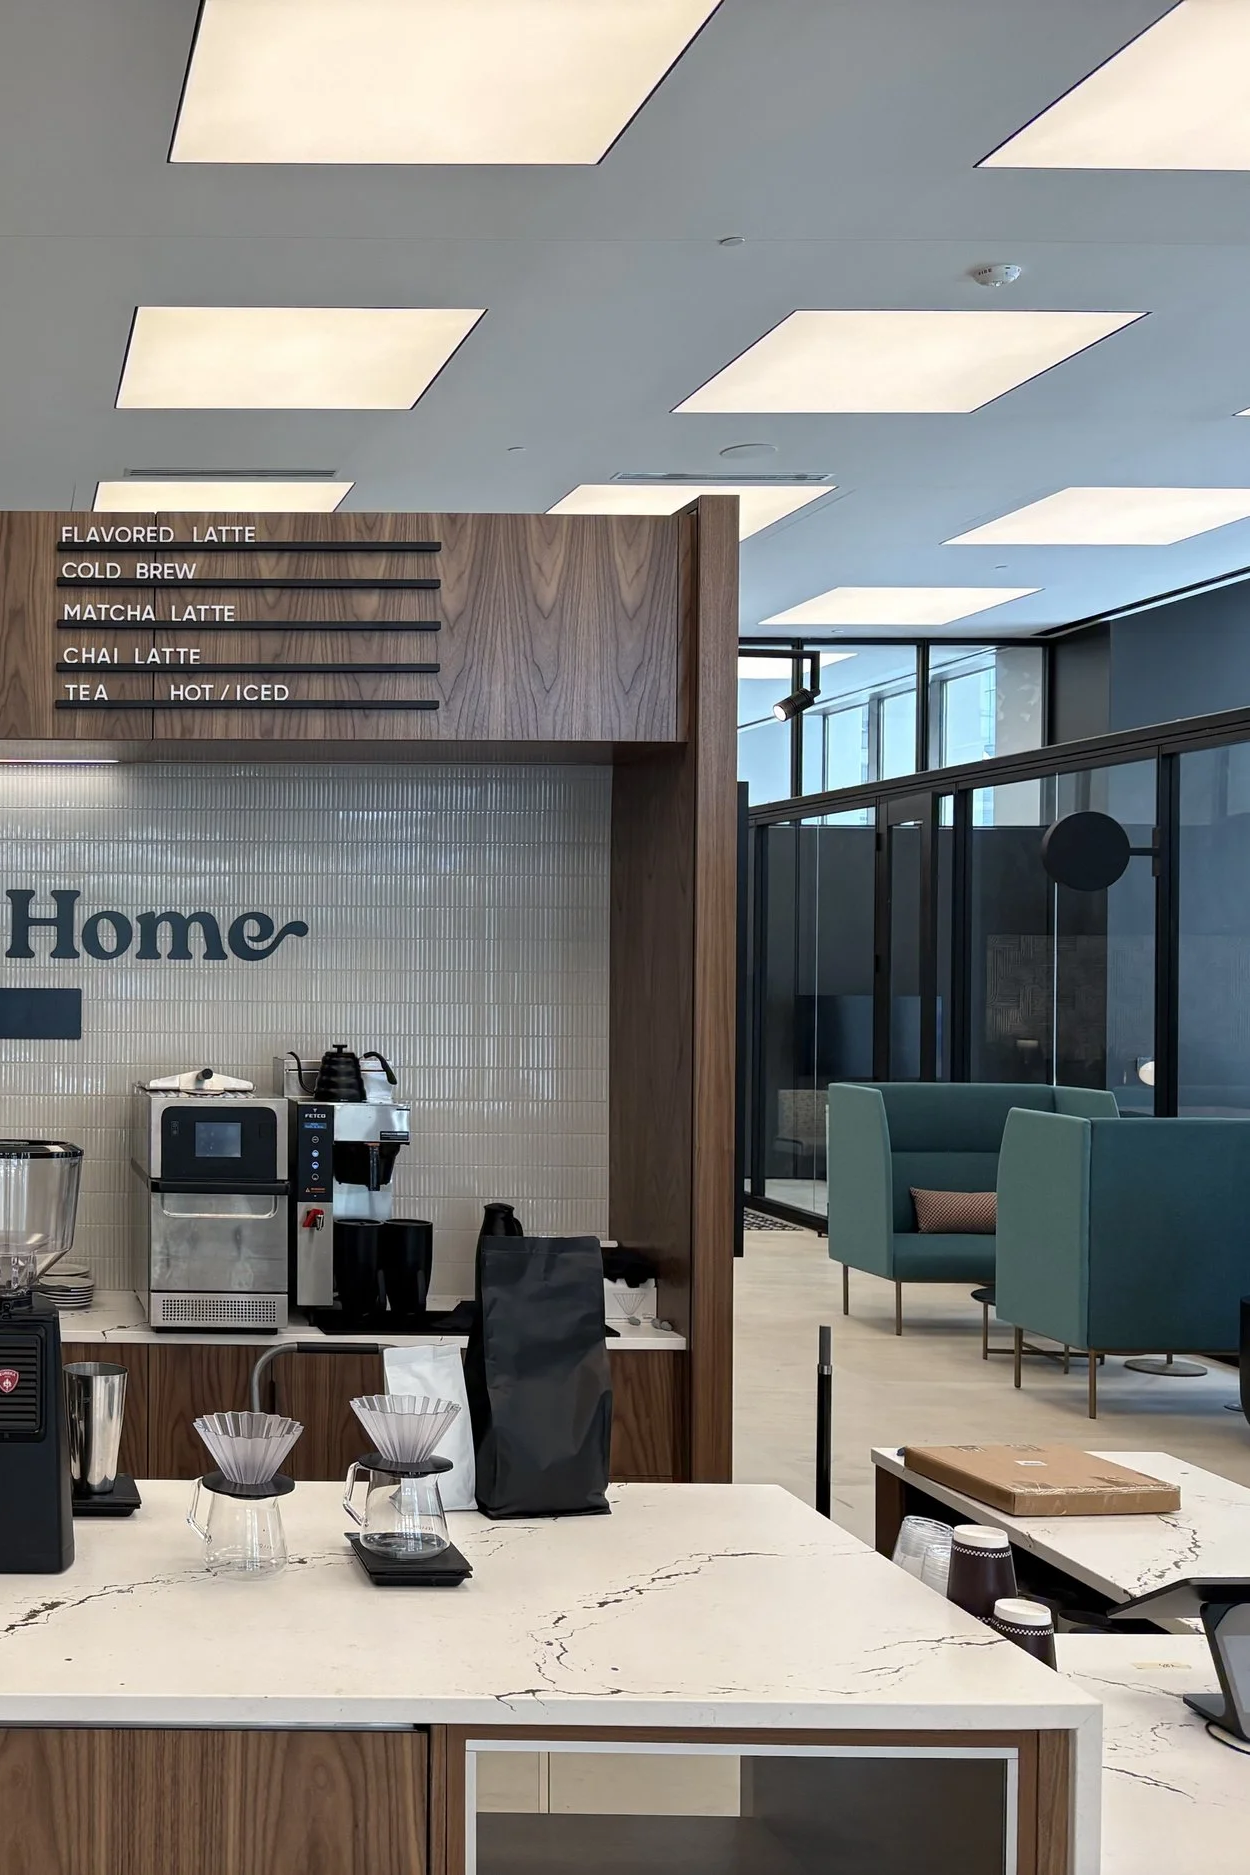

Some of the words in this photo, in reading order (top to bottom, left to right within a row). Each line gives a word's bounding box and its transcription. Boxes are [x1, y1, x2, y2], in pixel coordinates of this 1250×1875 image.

[61, 526, 175, 543] FLAVORED
[192, 526, 256, 543] LATTE
[61, 561, 122, 580] COLD
[136, 562, 197, 580] BREW
[64, 603, 156, 622] MATCHA
[171, 604, 236, 622] LATTE
[62, 647, 118, 665] CHAI
[134, 647, 201, 665] LATTE
[64, 684, 109, 701] TEA
[5, 888, 309, 962] Home
